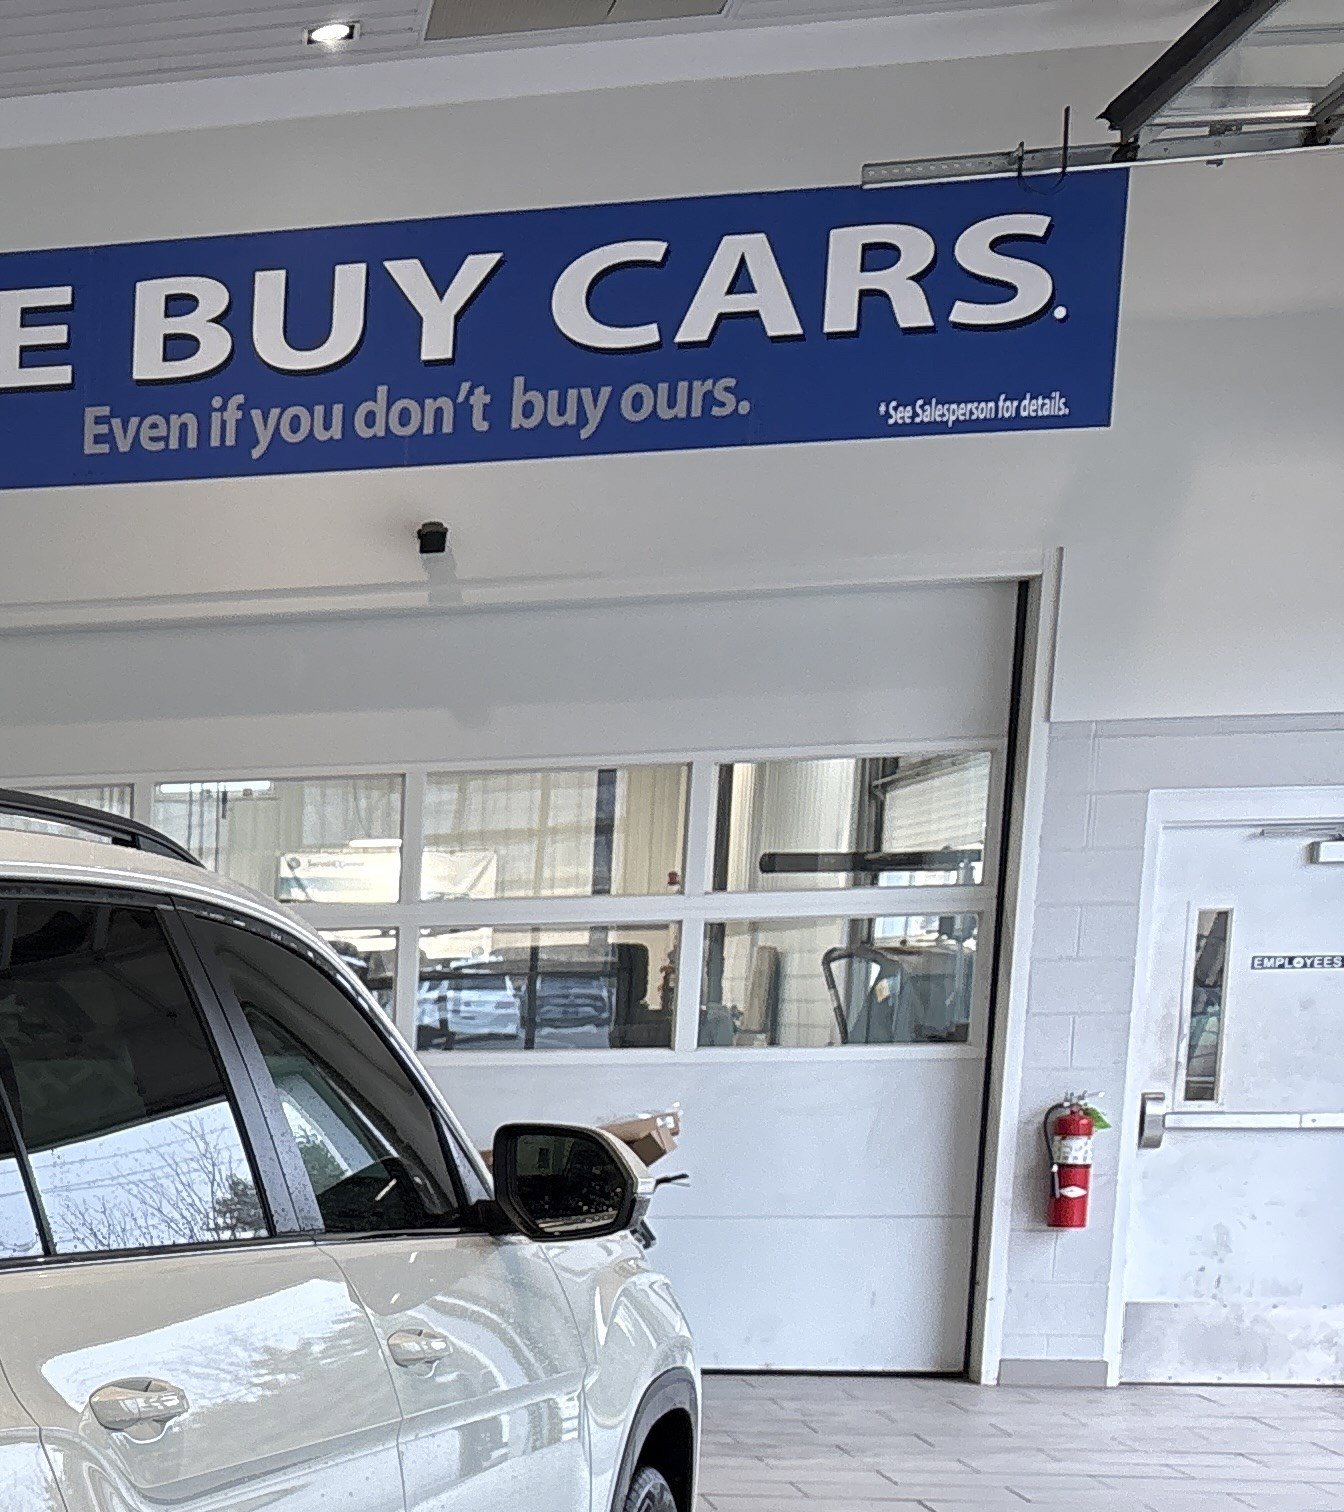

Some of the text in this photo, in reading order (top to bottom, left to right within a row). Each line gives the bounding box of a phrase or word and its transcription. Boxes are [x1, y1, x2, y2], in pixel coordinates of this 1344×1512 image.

[132, 252, 505, 387] BUY
[551, 212, 1068, 356] CARS.
[83, 375, 751, 460] Even if you don’t buy ours.
[914, 397, 995, 428] Salesperson
[997, 394, 1019, 418] for
[1020, 391, 1070, 418] details.
[1252, 957, 1343, 969] EMPLOYEES
